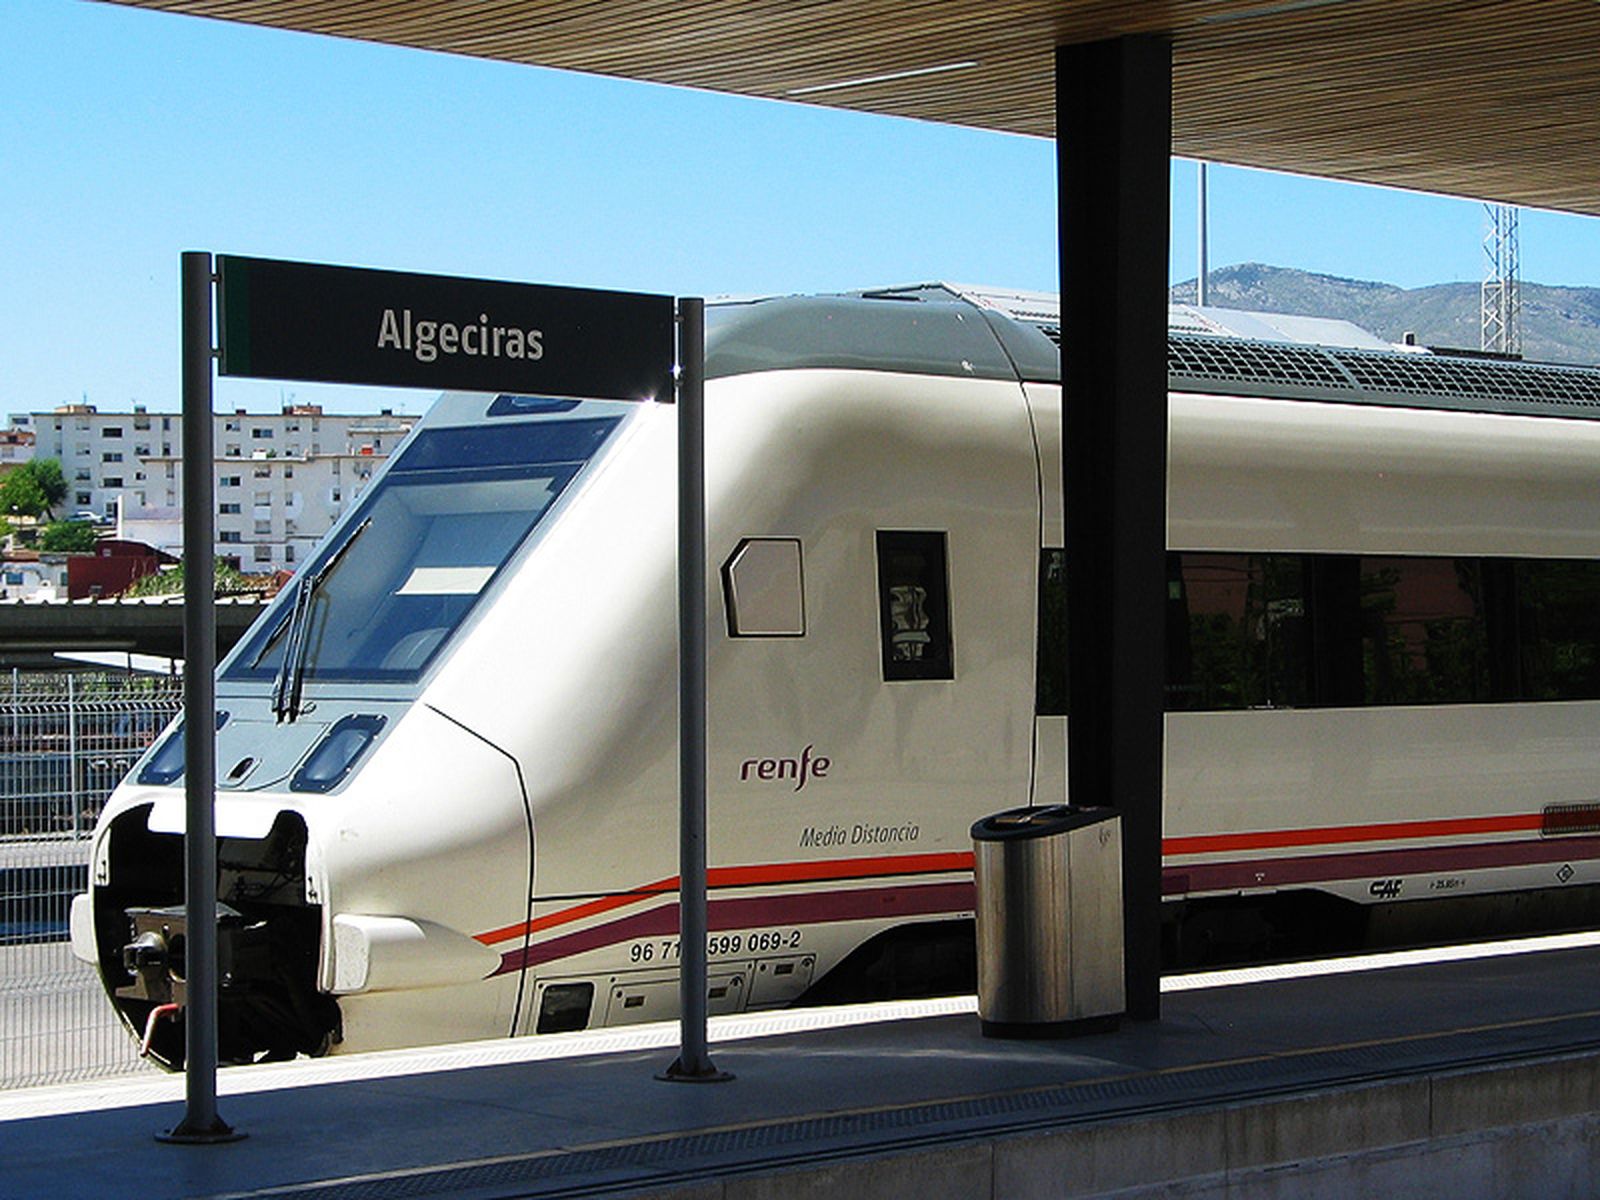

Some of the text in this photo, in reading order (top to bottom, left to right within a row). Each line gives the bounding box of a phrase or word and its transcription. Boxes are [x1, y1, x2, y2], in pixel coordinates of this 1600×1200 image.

[377, 309, 544, 363] Algeciras
[740, 744, 831, 793] renfe
[799, 821, 920, 848] Media Distancia
[1369, 879, 1403, 899] CAF
[630, 943, 653, 963] 96
[707, 935, 741, 955] 599
[747, 930, 801, 951] 069-2
